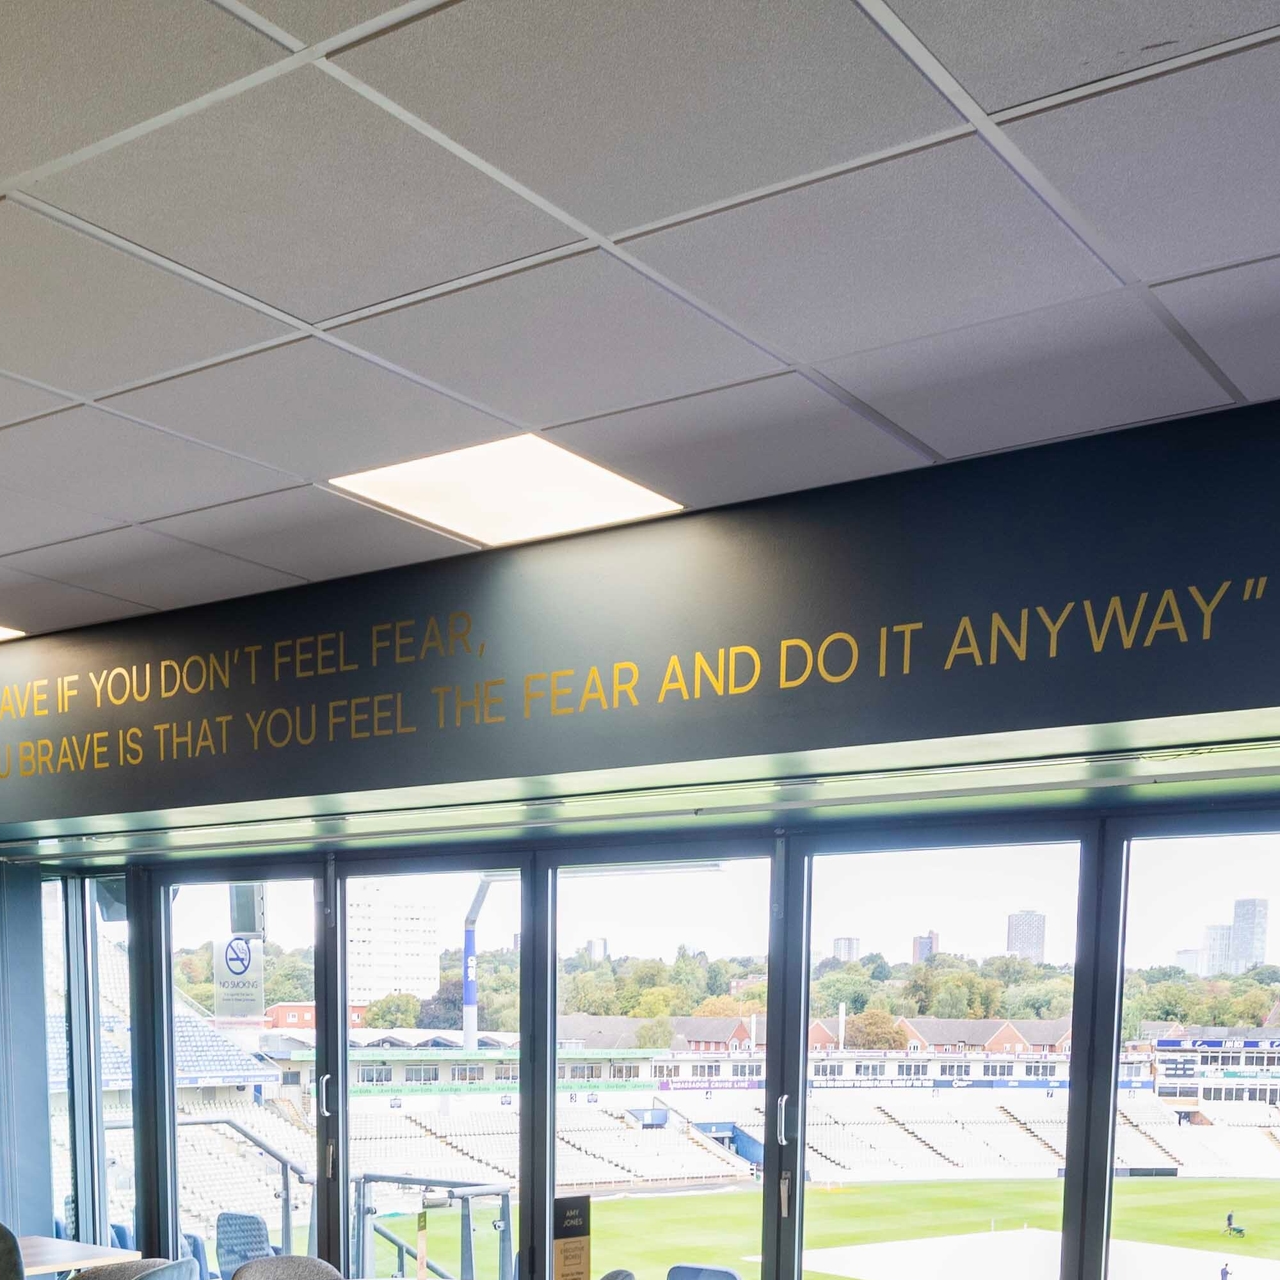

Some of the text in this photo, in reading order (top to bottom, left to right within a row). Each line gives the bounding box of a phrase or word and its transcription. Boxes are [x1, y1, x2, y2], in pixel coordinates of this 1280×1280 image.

[57, 673, 80, 713] IF
[89, 660, 152, 711] YOU
[160, 644, 262, 698] DON'T
[275, 631, 349, 681] FEEL
[372, 609, 487, 668] FEAR,
[18, 731, 111, 777] BRAVE
[118, 728, 143, 766] IS
[152, 714, 231, 763] THAT
[245, 703, 317, 750] YOU
[328, 693, 418, 742] FEEL
[435, 678, 506, 728] THE
[523, 661, 640, 720] FEAR
[657, 645, 762, 704] AND
[779, 631, 859, 688] DO
[878, 621, 924, 678] IT
[219, 980, 258, 989] NO SMOKING
[565, 1209, 580, 1217] AMY
[562, 1217, 583, 1227] JONES
